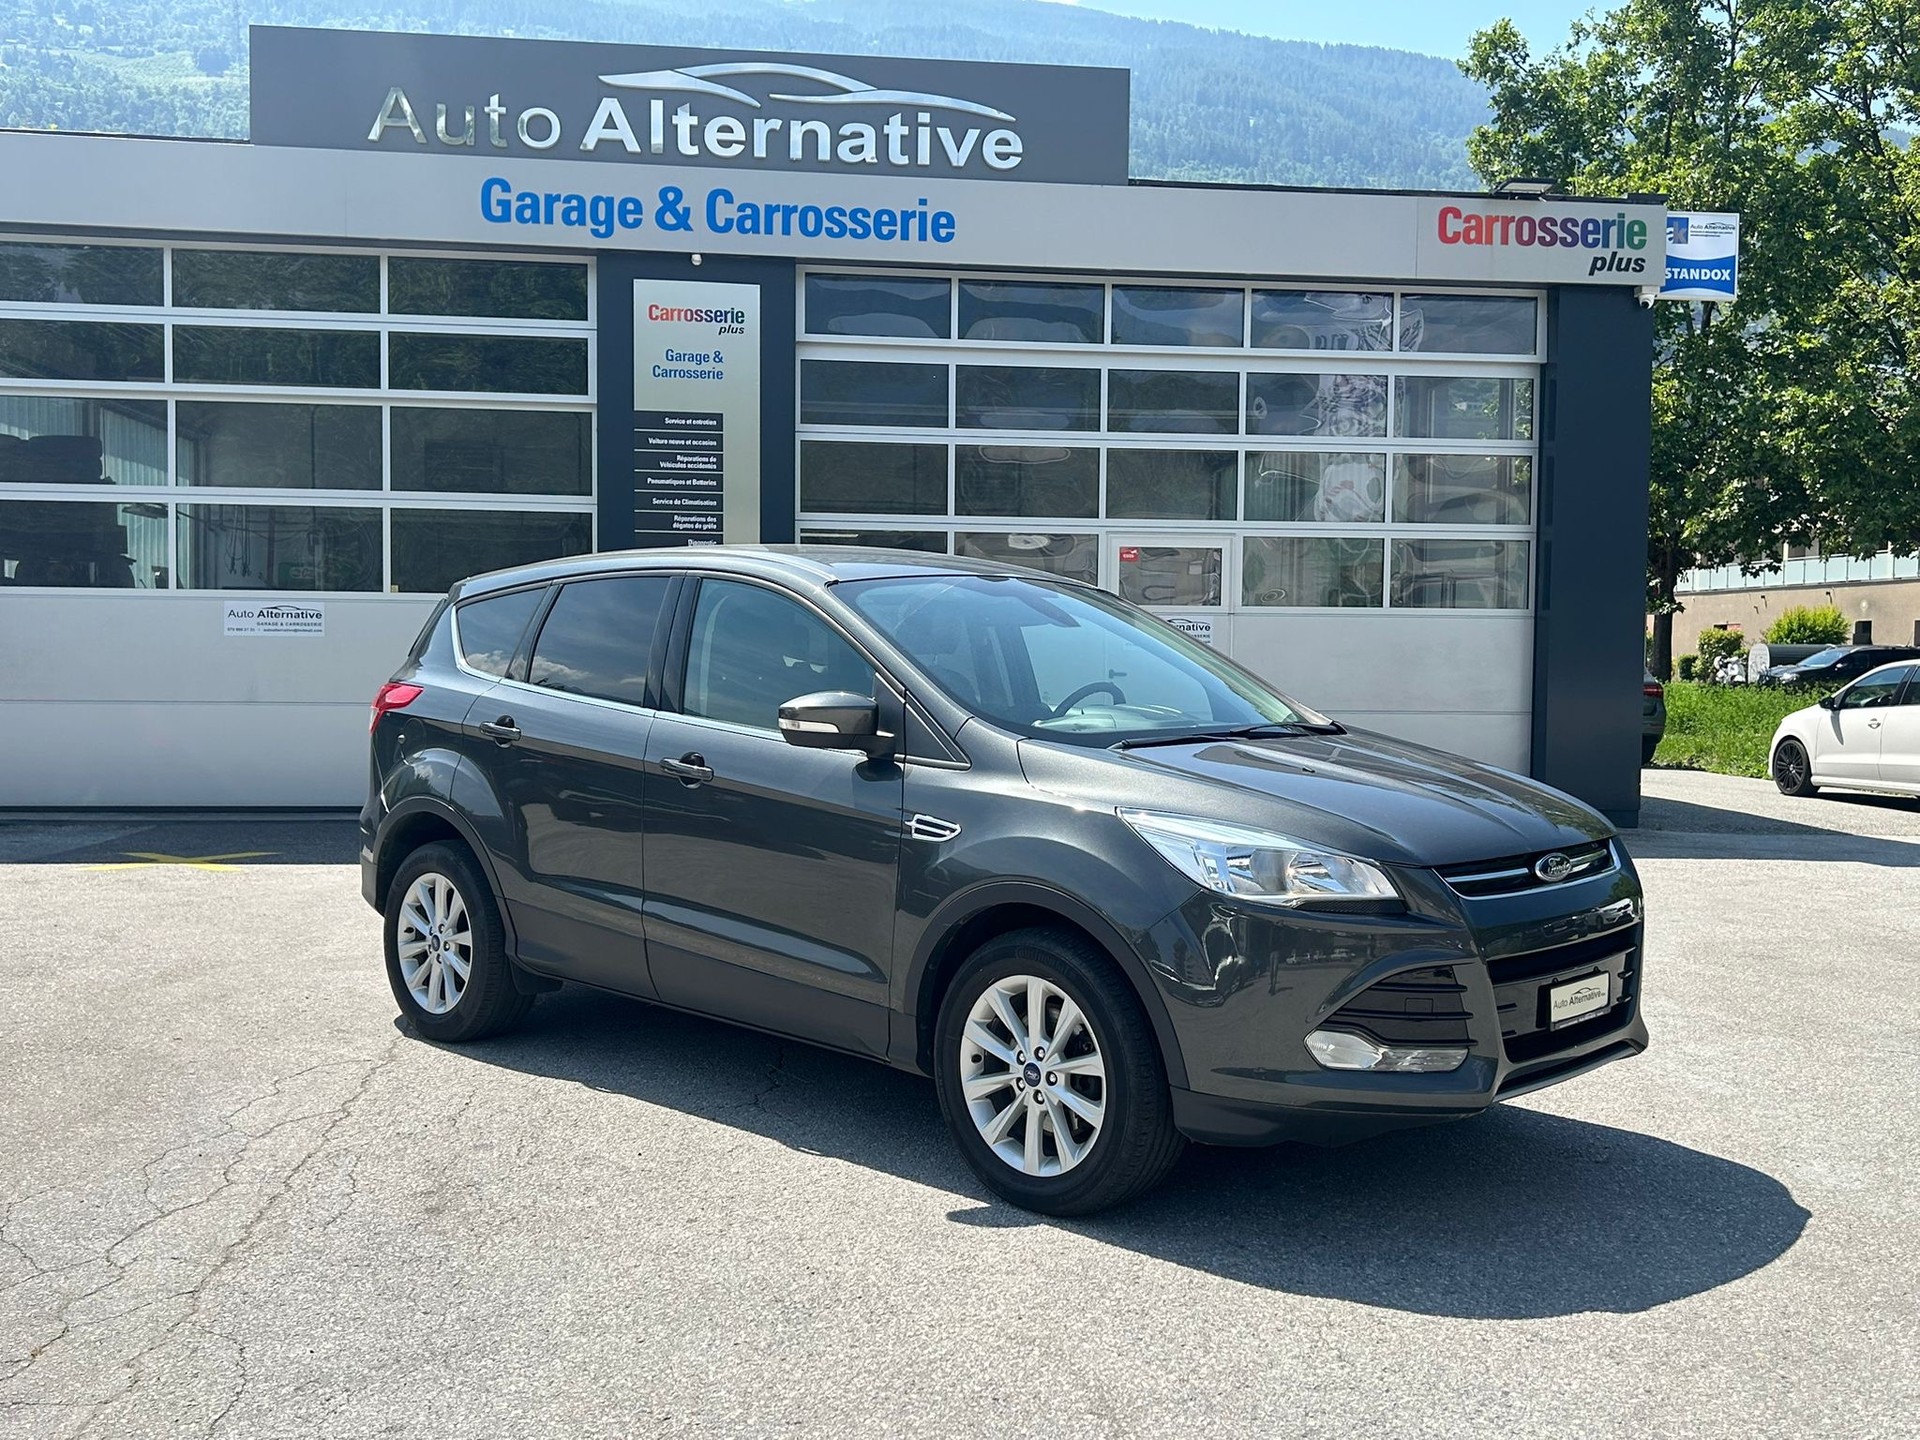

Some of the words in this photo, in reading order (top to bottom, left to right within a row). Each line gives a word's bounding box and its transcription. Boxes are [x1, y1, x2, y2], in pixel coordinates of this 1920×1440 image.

[368, 86, 562, 151] Auto
[580, 97, 1024, 170] Alternative
[480, 177, 643, 240] Garage
[654, 188, 692, 230] &
[705, 188, 956, 243] Carrosserie
[1438, 206, 1647, 250] Carrosserie
[1588, 251, 1646, 276] plus
[1665, 267, 1731, 281] STANDOX
[648, 304, 745, 324] Carrosserie
[718, 325, 745, 335] plus
[665, 349, 710, 365] Garage
[713, 350, 724, 363] &
[652, 365, 724, 380] Carrosserie
[664, 417, 685, 425] Service
[692, 439, 717, 447] occasion
[647, 477, 685, 487] Pneumatiques
[652, 498, 673, 506] Service
[682, 499, 717, 507] Climatisation
[227, 609, 255, 619] Auto
[257, 610, 323, 620] Alternative
[1553, 1000, 1568, 1010] Auto
[1568, 990, 1601, 1006] Alternative
